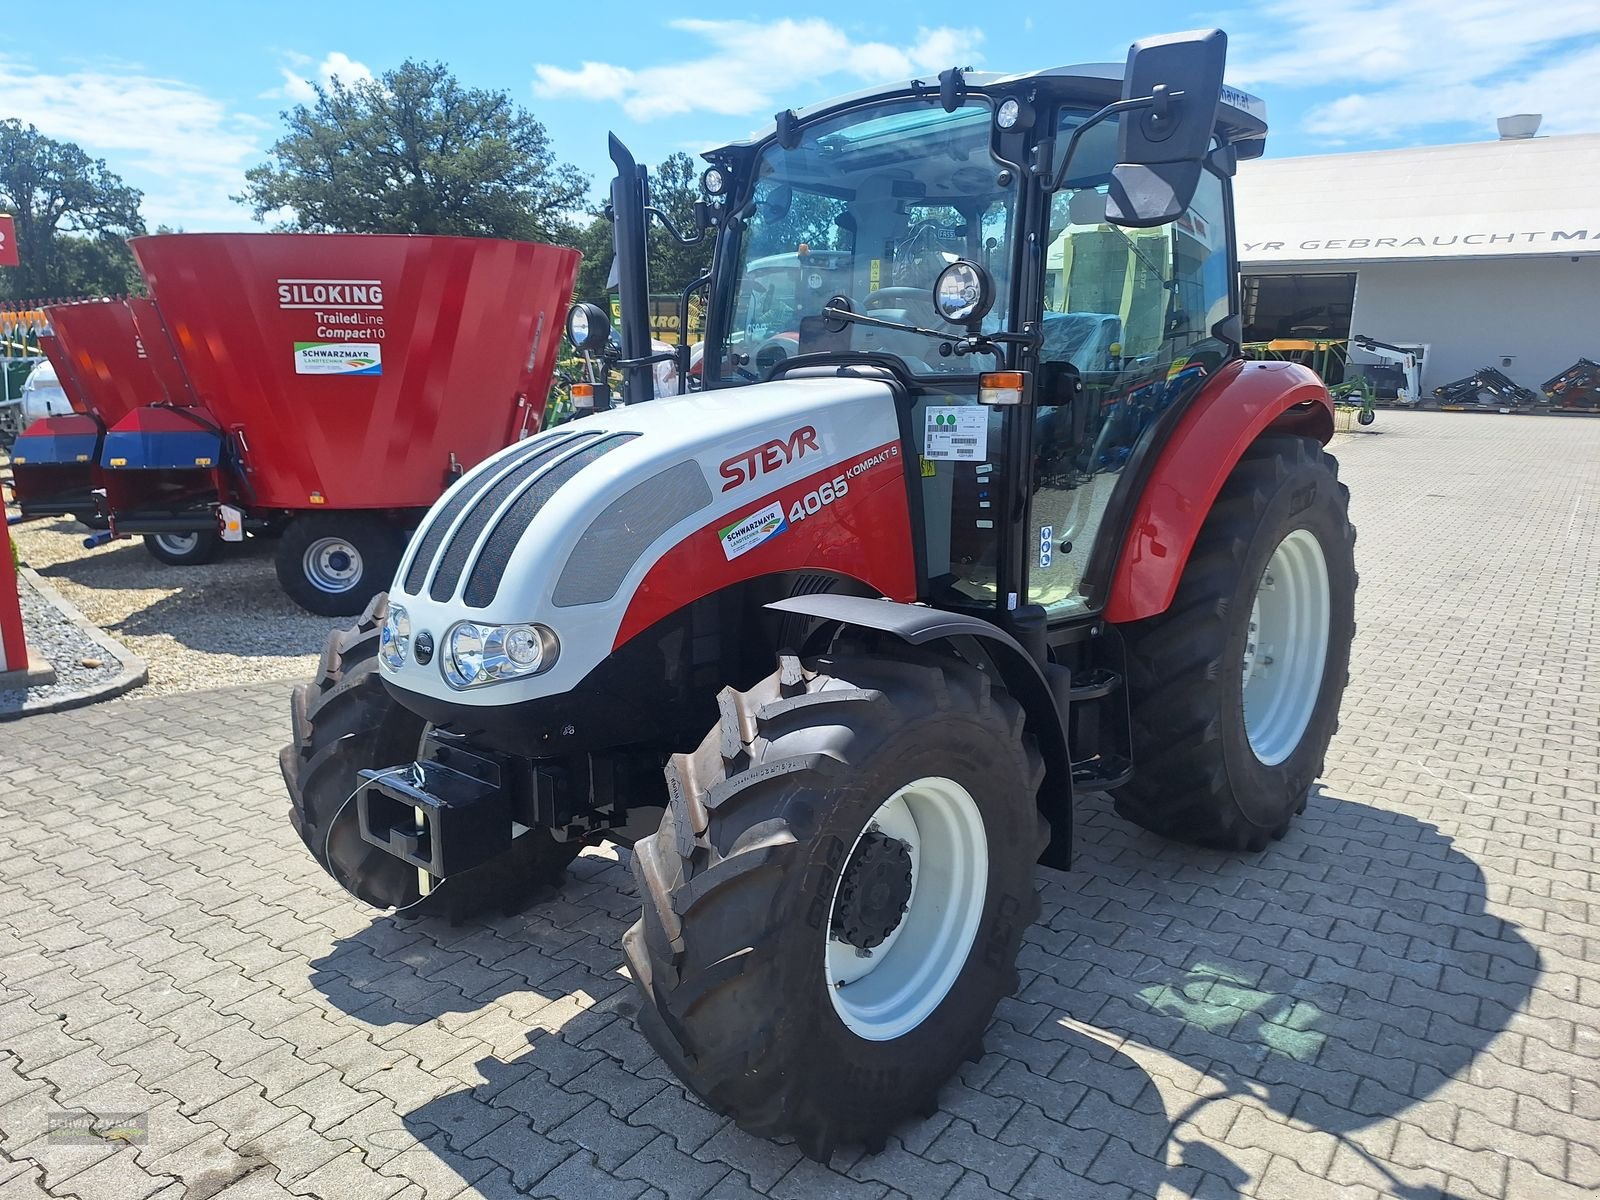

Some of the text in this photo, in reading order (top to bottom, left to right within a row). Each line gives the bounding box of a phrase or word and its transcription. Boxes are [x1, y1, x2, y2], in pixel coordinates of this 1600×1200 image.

[278, 285, 383, 303] SILOKING
[315, 312, 383, 325] TrailedLine
[317, 326, 385, 341] Compact10
[302, 350, 369, 358] SCHWARZMAYR
[719, 425, 819, 492] STEYR
[789, 475, 849, 524] 4065
[846, 449, 890, 479] KOMPAKT
[891, 446, 898, 456] S
[727, 512, 776, 542] SCHWARZMAYR
